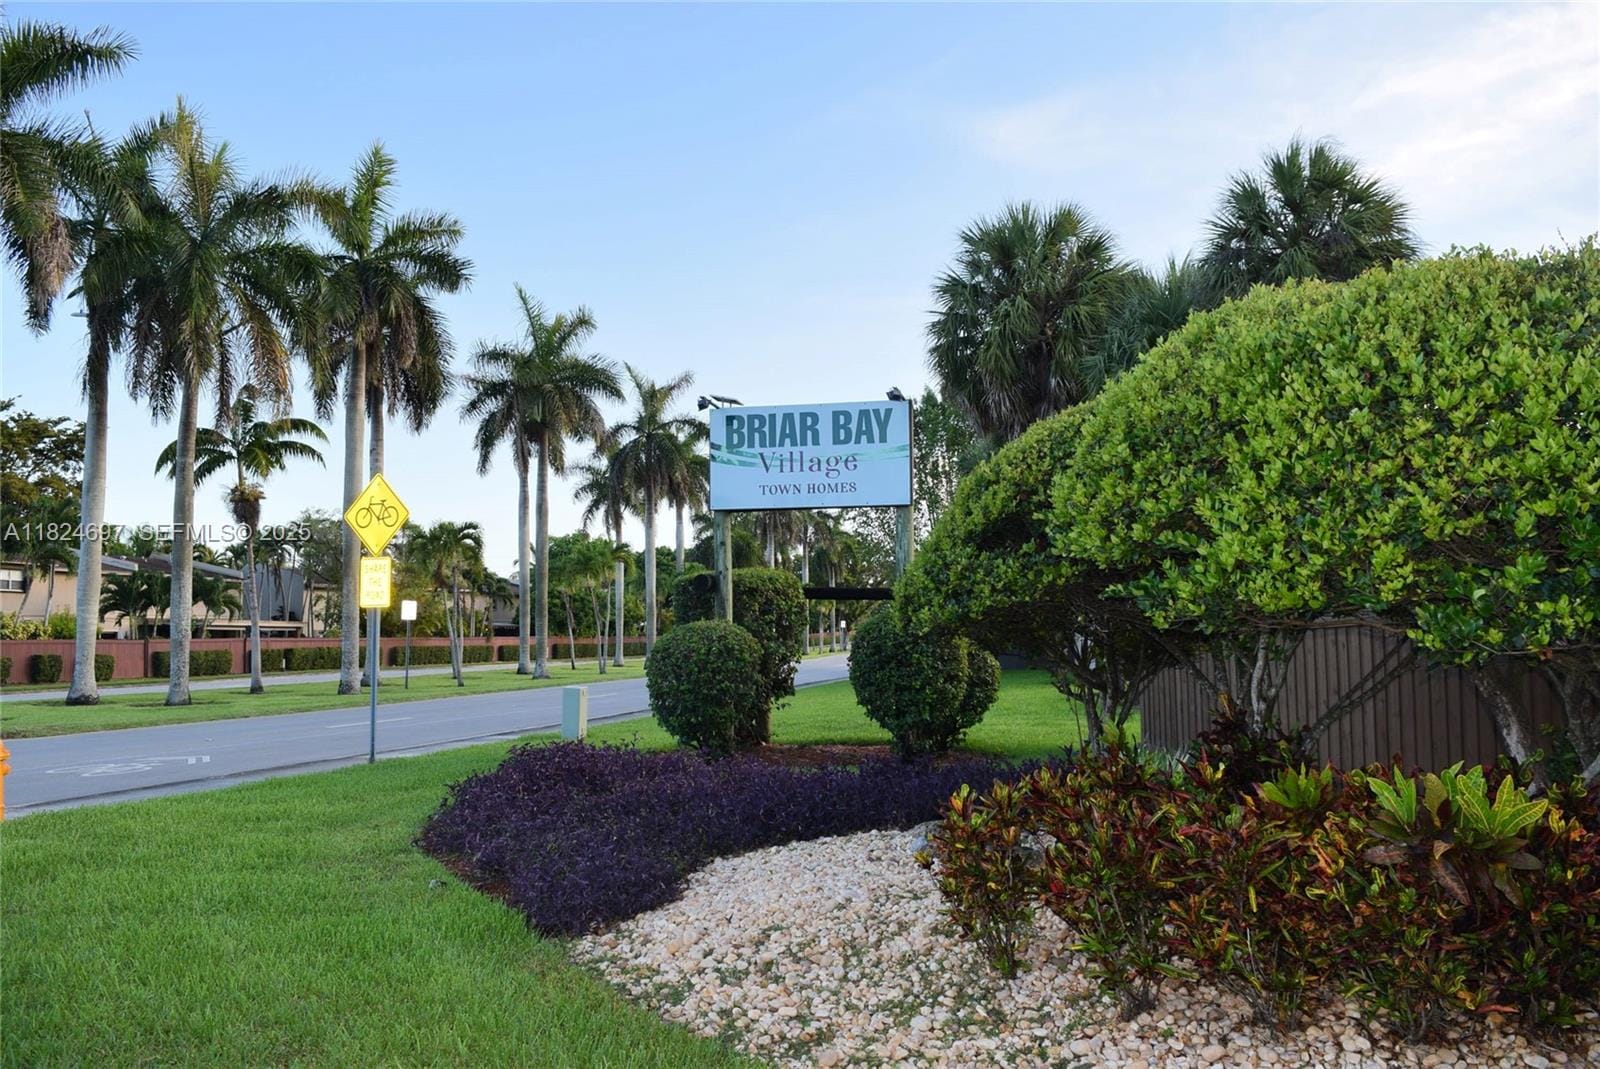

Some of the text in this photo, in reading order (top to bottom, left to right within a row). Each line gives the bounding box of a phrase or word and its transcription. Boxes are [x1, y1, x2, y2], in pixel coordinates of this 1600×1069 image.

[725, 408, 893, 450] BRIAR BAY
[758, 451, 858, 479] Village
[759, 482, 857, 496] TOWN HOMES
